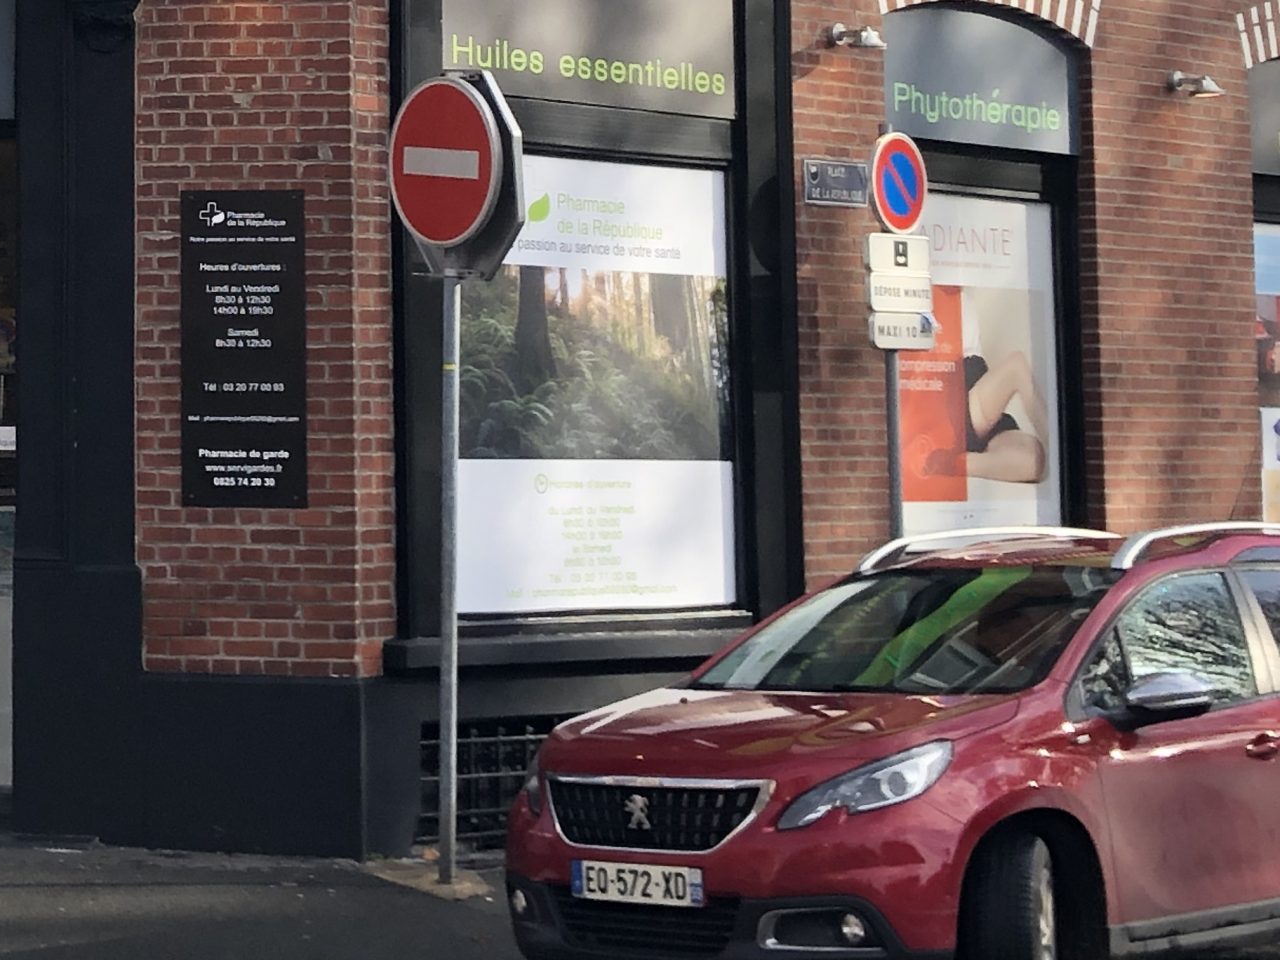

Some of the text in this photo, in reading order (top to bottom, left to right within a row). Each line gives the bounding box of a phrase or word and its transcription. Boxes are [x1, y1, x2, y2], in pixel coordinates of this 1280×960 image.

[451, 33, 726, 95] Huiles essentielles
[893, 82, 1061, 133] Phytothérapie
[557, 193, 625, 215] Pharmacie
[557, 218, 664, 241] de la République
[518, 239, 557, 253] passion
[559, 241, 573, 253] au
[575, 241, 610, 256] service
[612, 243, 626, 257] de
[628, 245, 652, 258] votre
[200, 263, 229, 271] Heures
[206, 284, 229, 293] Lundi
[243, 284, 280, 293] Vendredi
[904, 288, 931, 300] MINUTE
[227, 328, 259, 336] Samedi
[878, 325, 918, 338] MAXI 10
[899, 360, 956, 374] ompression
[199, 449, 290, 460] Pharmacie de garde
[237, 477, 249, 486] 74
